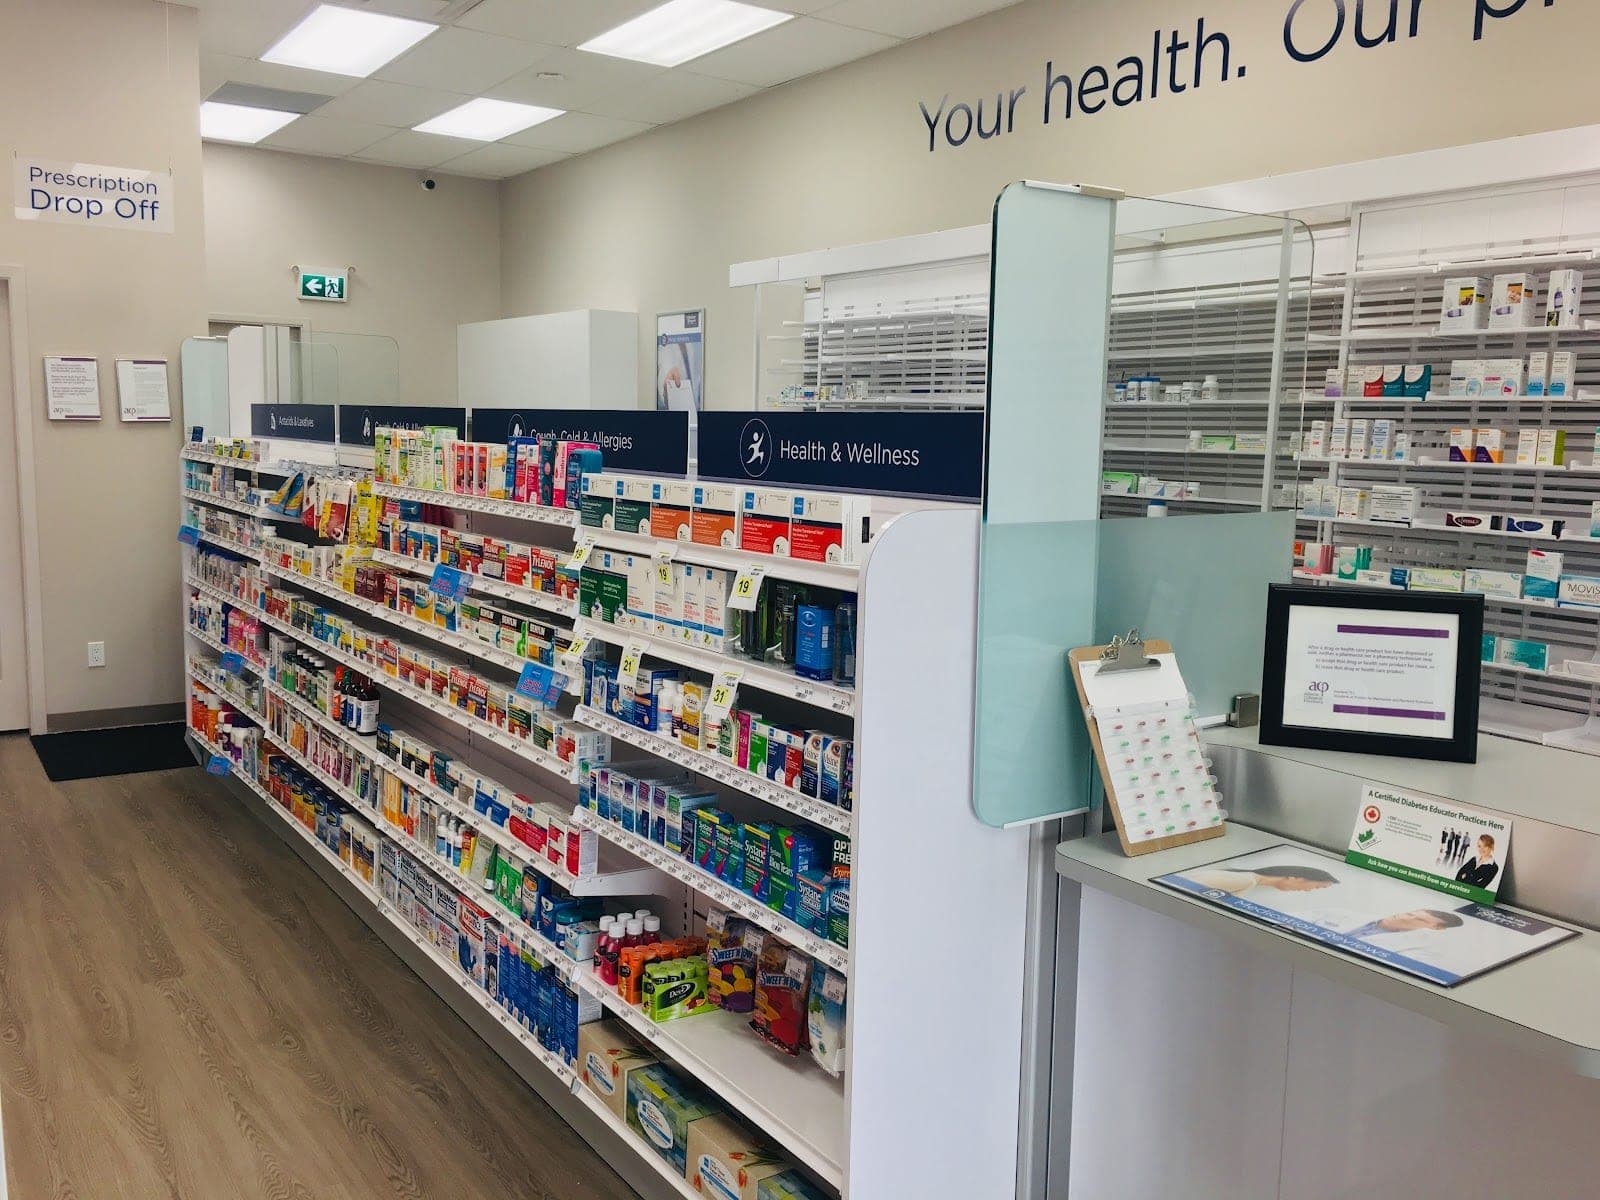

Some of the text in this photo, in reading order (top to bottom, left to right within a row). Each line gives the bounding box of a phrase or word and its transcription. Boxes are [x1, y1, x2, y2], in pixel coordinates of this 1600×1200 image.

[919, 86, 1026, 153] Your
[1042, 16, 1247, 126] health.
[29, 166, 157, 195] Prescription
[31, 188, 160, 221] Drop Off
[593, 432, 633, 452] Allergies
[780, 439, 920, 466] Health & Wellness
[738, 579, 750, 593] 19
[623, 658, 633, 673] 21
[713, 688, 726, 704] 31
[1374, 791, 1400, 804] Certified
[1401, 797, 1428, 811] Diabetes
[1429, 804, 1458, 819] Educator
[1458, 812, 1487, 827] Practices
[1488, 819, 1505, 831] Here
[744, 839, 766, 860] Systane
[799, 880, 821, 901] Systane
[1234, 900, 1389, 958] Medication Reviews
